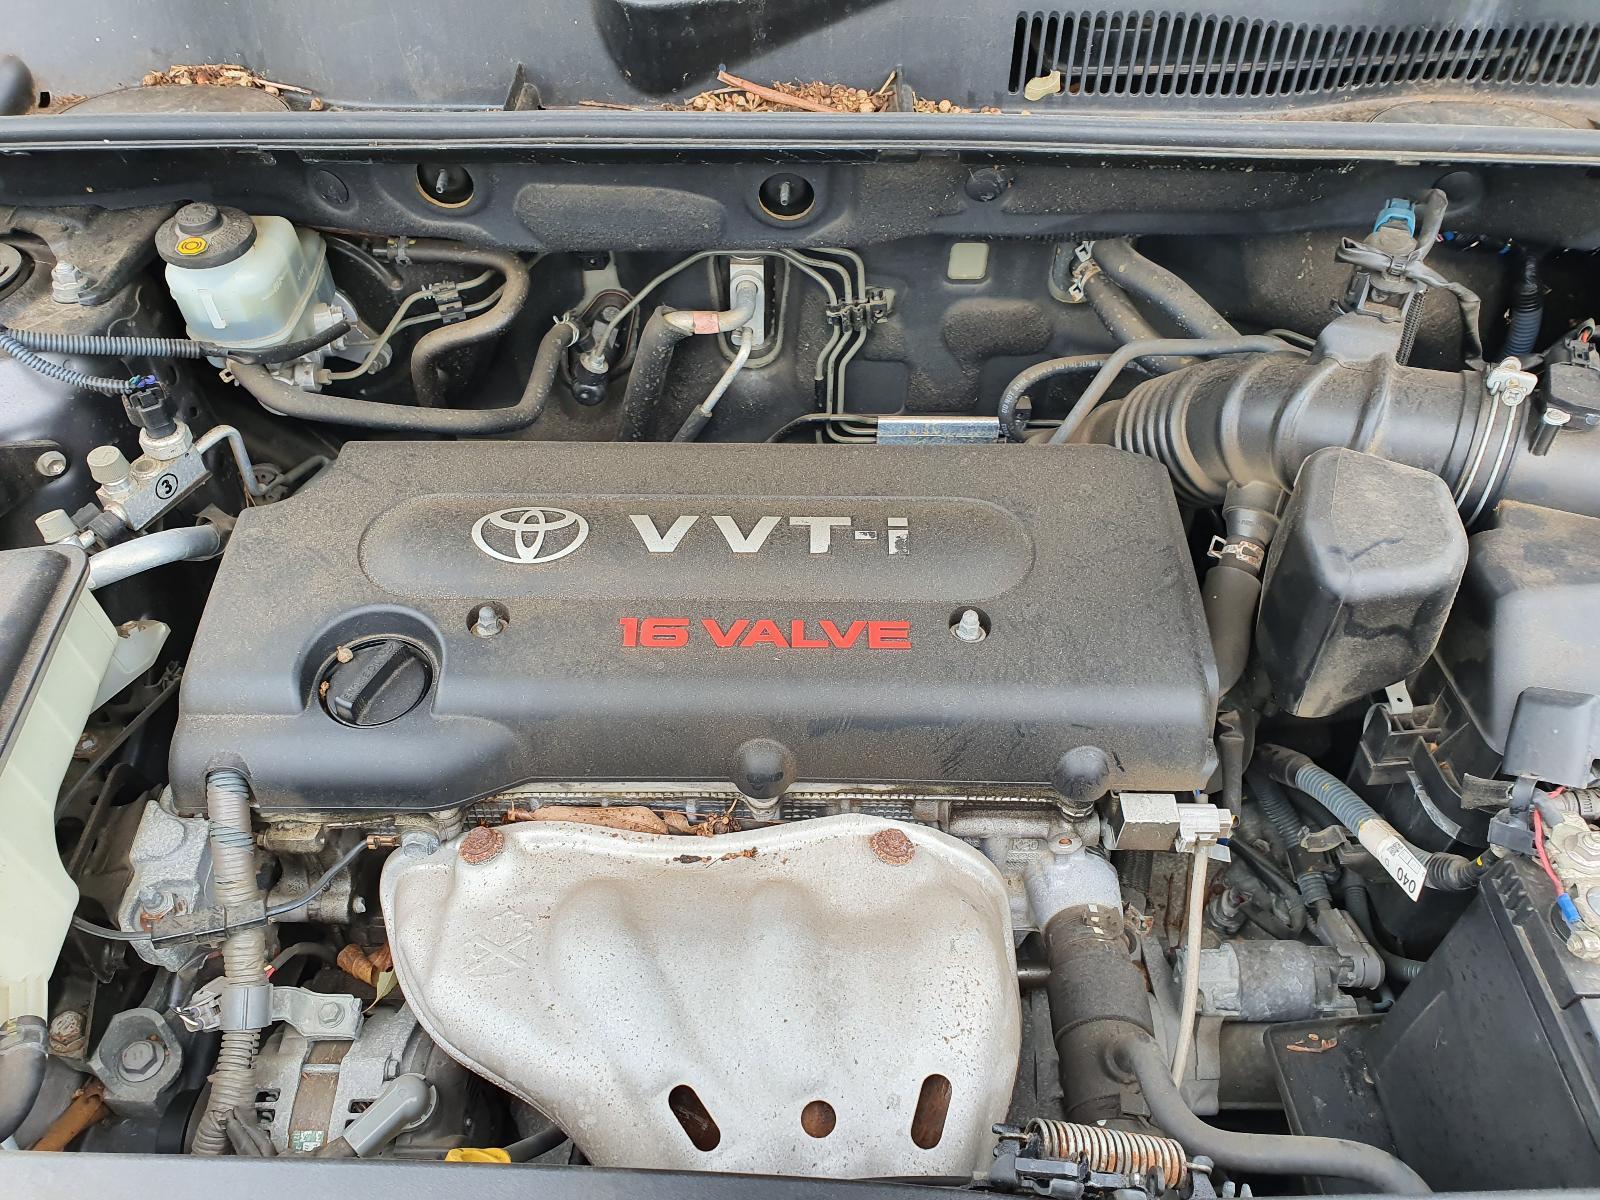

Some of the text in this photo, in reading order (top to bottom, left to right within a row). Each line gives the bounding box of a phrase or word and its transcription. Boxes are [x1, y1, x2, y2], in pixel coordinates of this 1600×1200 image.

[629, 515, 909, 555] VVT-i
[620, 617, 912, 649] 16 VALVE
[1397, 867, 1416, 893] 040
